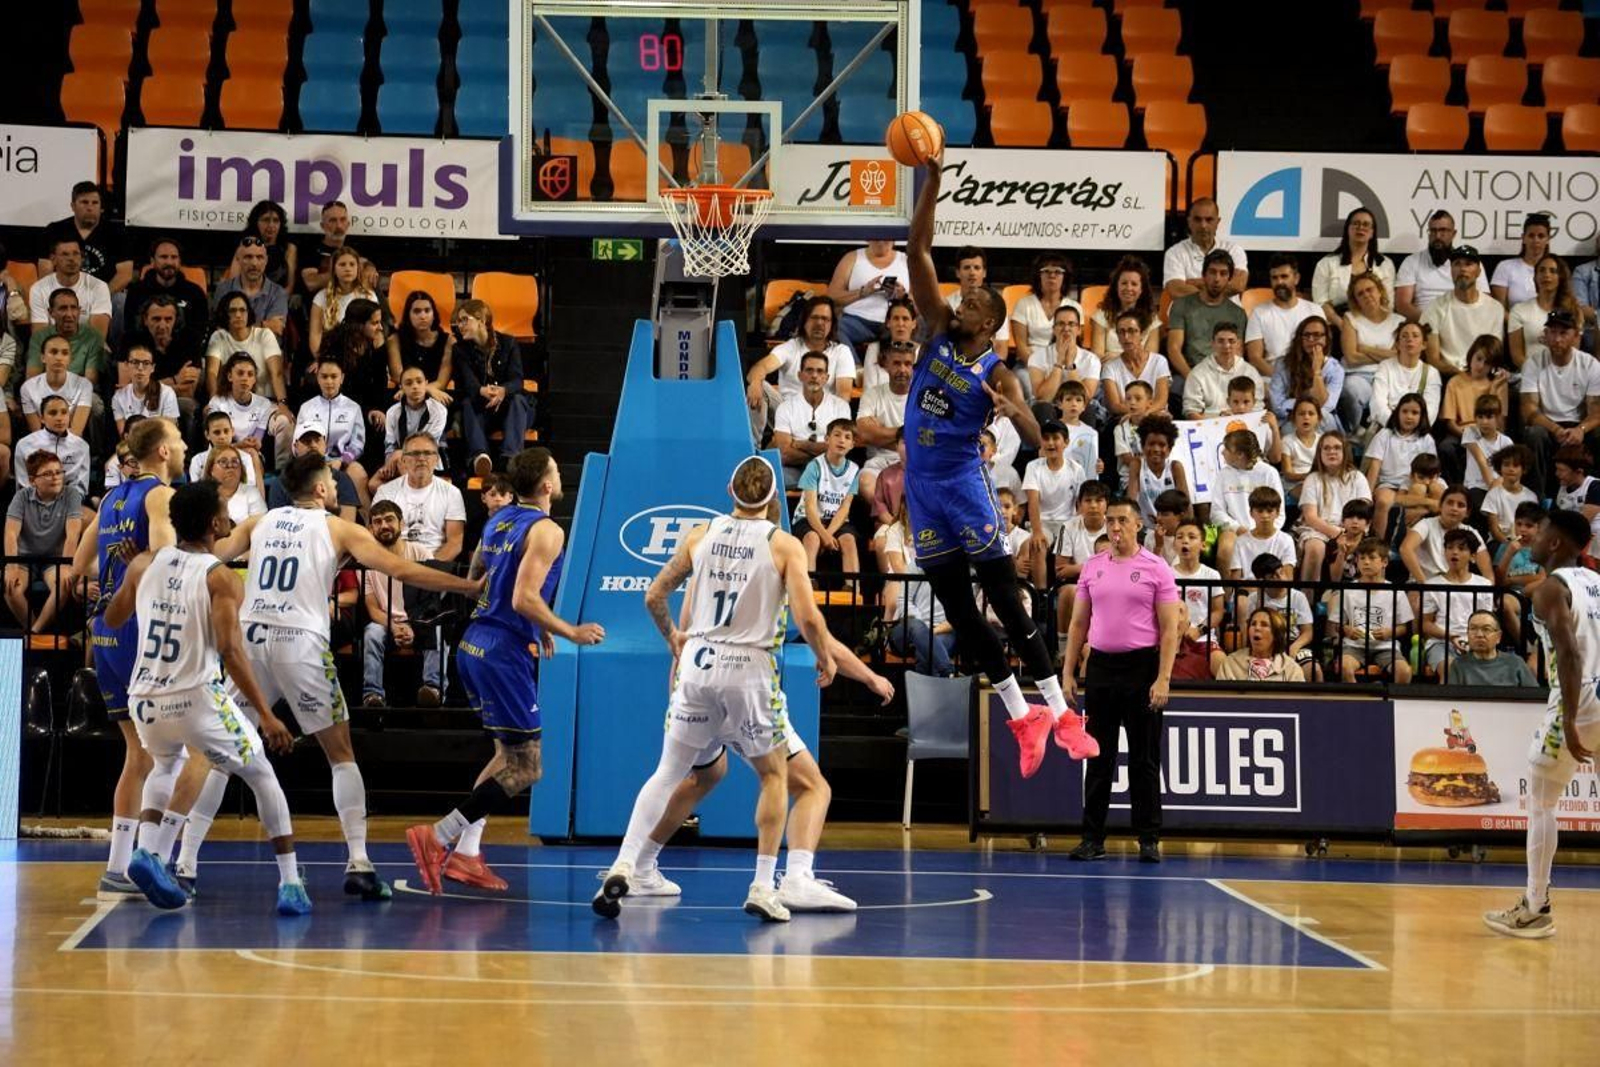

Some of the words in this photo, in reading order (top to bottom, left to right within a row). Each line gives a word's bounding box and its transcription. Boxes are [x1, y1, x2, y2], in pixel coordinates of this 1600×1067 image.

[0, 135, 39, 174] ia
[178, 137, 470, 225] impuls
[799, 161, 851, 206] Jo
[935, 160, 1123, 212] Carreras
[1411, 168, 1599, 202] ANTONIO
[179, 209, 248, 225] FISIOTER
[351, 215, 469, 231] PODOLOGIA
[934, 220, 985, 237] INTERIA
[711, 542, 754, 561] LITTLESON
[258, 555, 300, 592] 00
[712, 589, 739, 627] 11
[143, 618, 183, 664] 55
[1110, 726, 1286, 797] ULES
